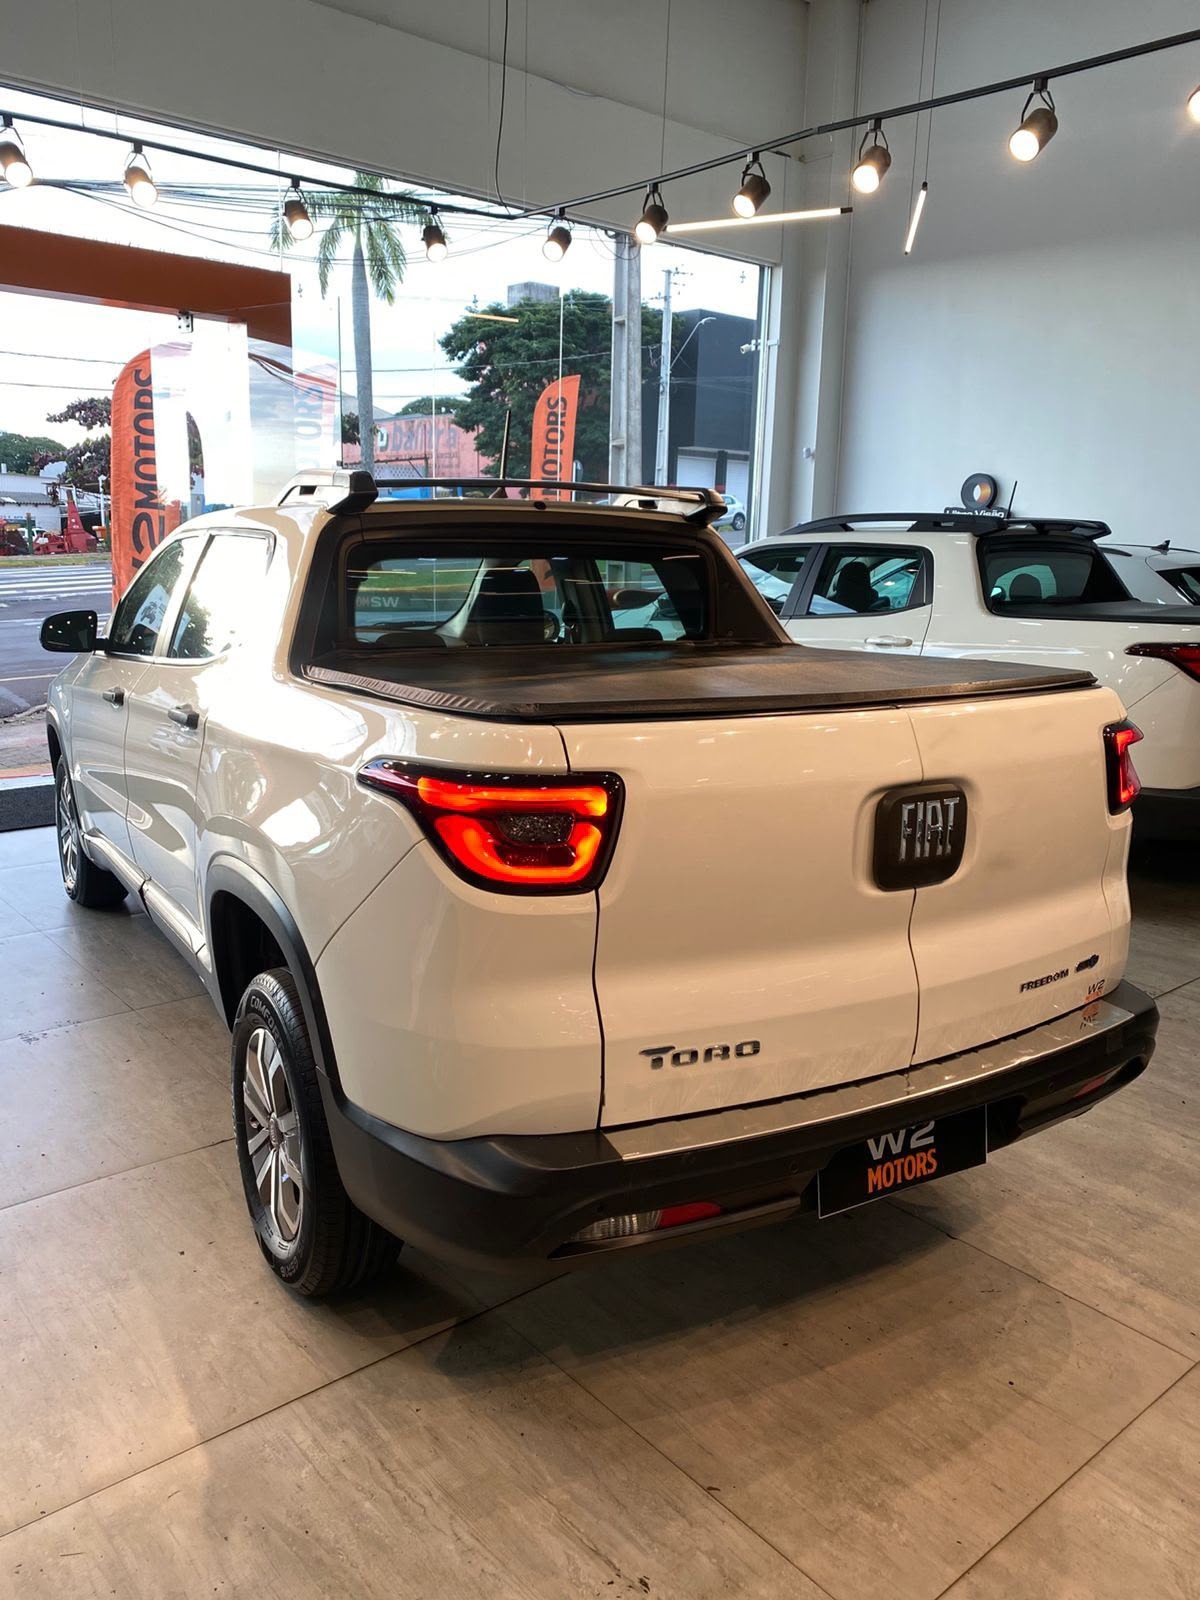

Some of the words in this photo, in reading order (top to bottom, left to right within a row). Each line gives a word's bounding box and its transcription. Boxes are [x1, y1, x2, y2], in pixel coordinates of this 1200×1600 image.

[900, 797, 960, 861] FIAT
[1019, 968, 1069, 994] FREEDOM
[638, 1040, 761, 1070] TORO
[866, 1120, 935, 1161] W2
[867, 1148, 937, 1194] MOTORS
